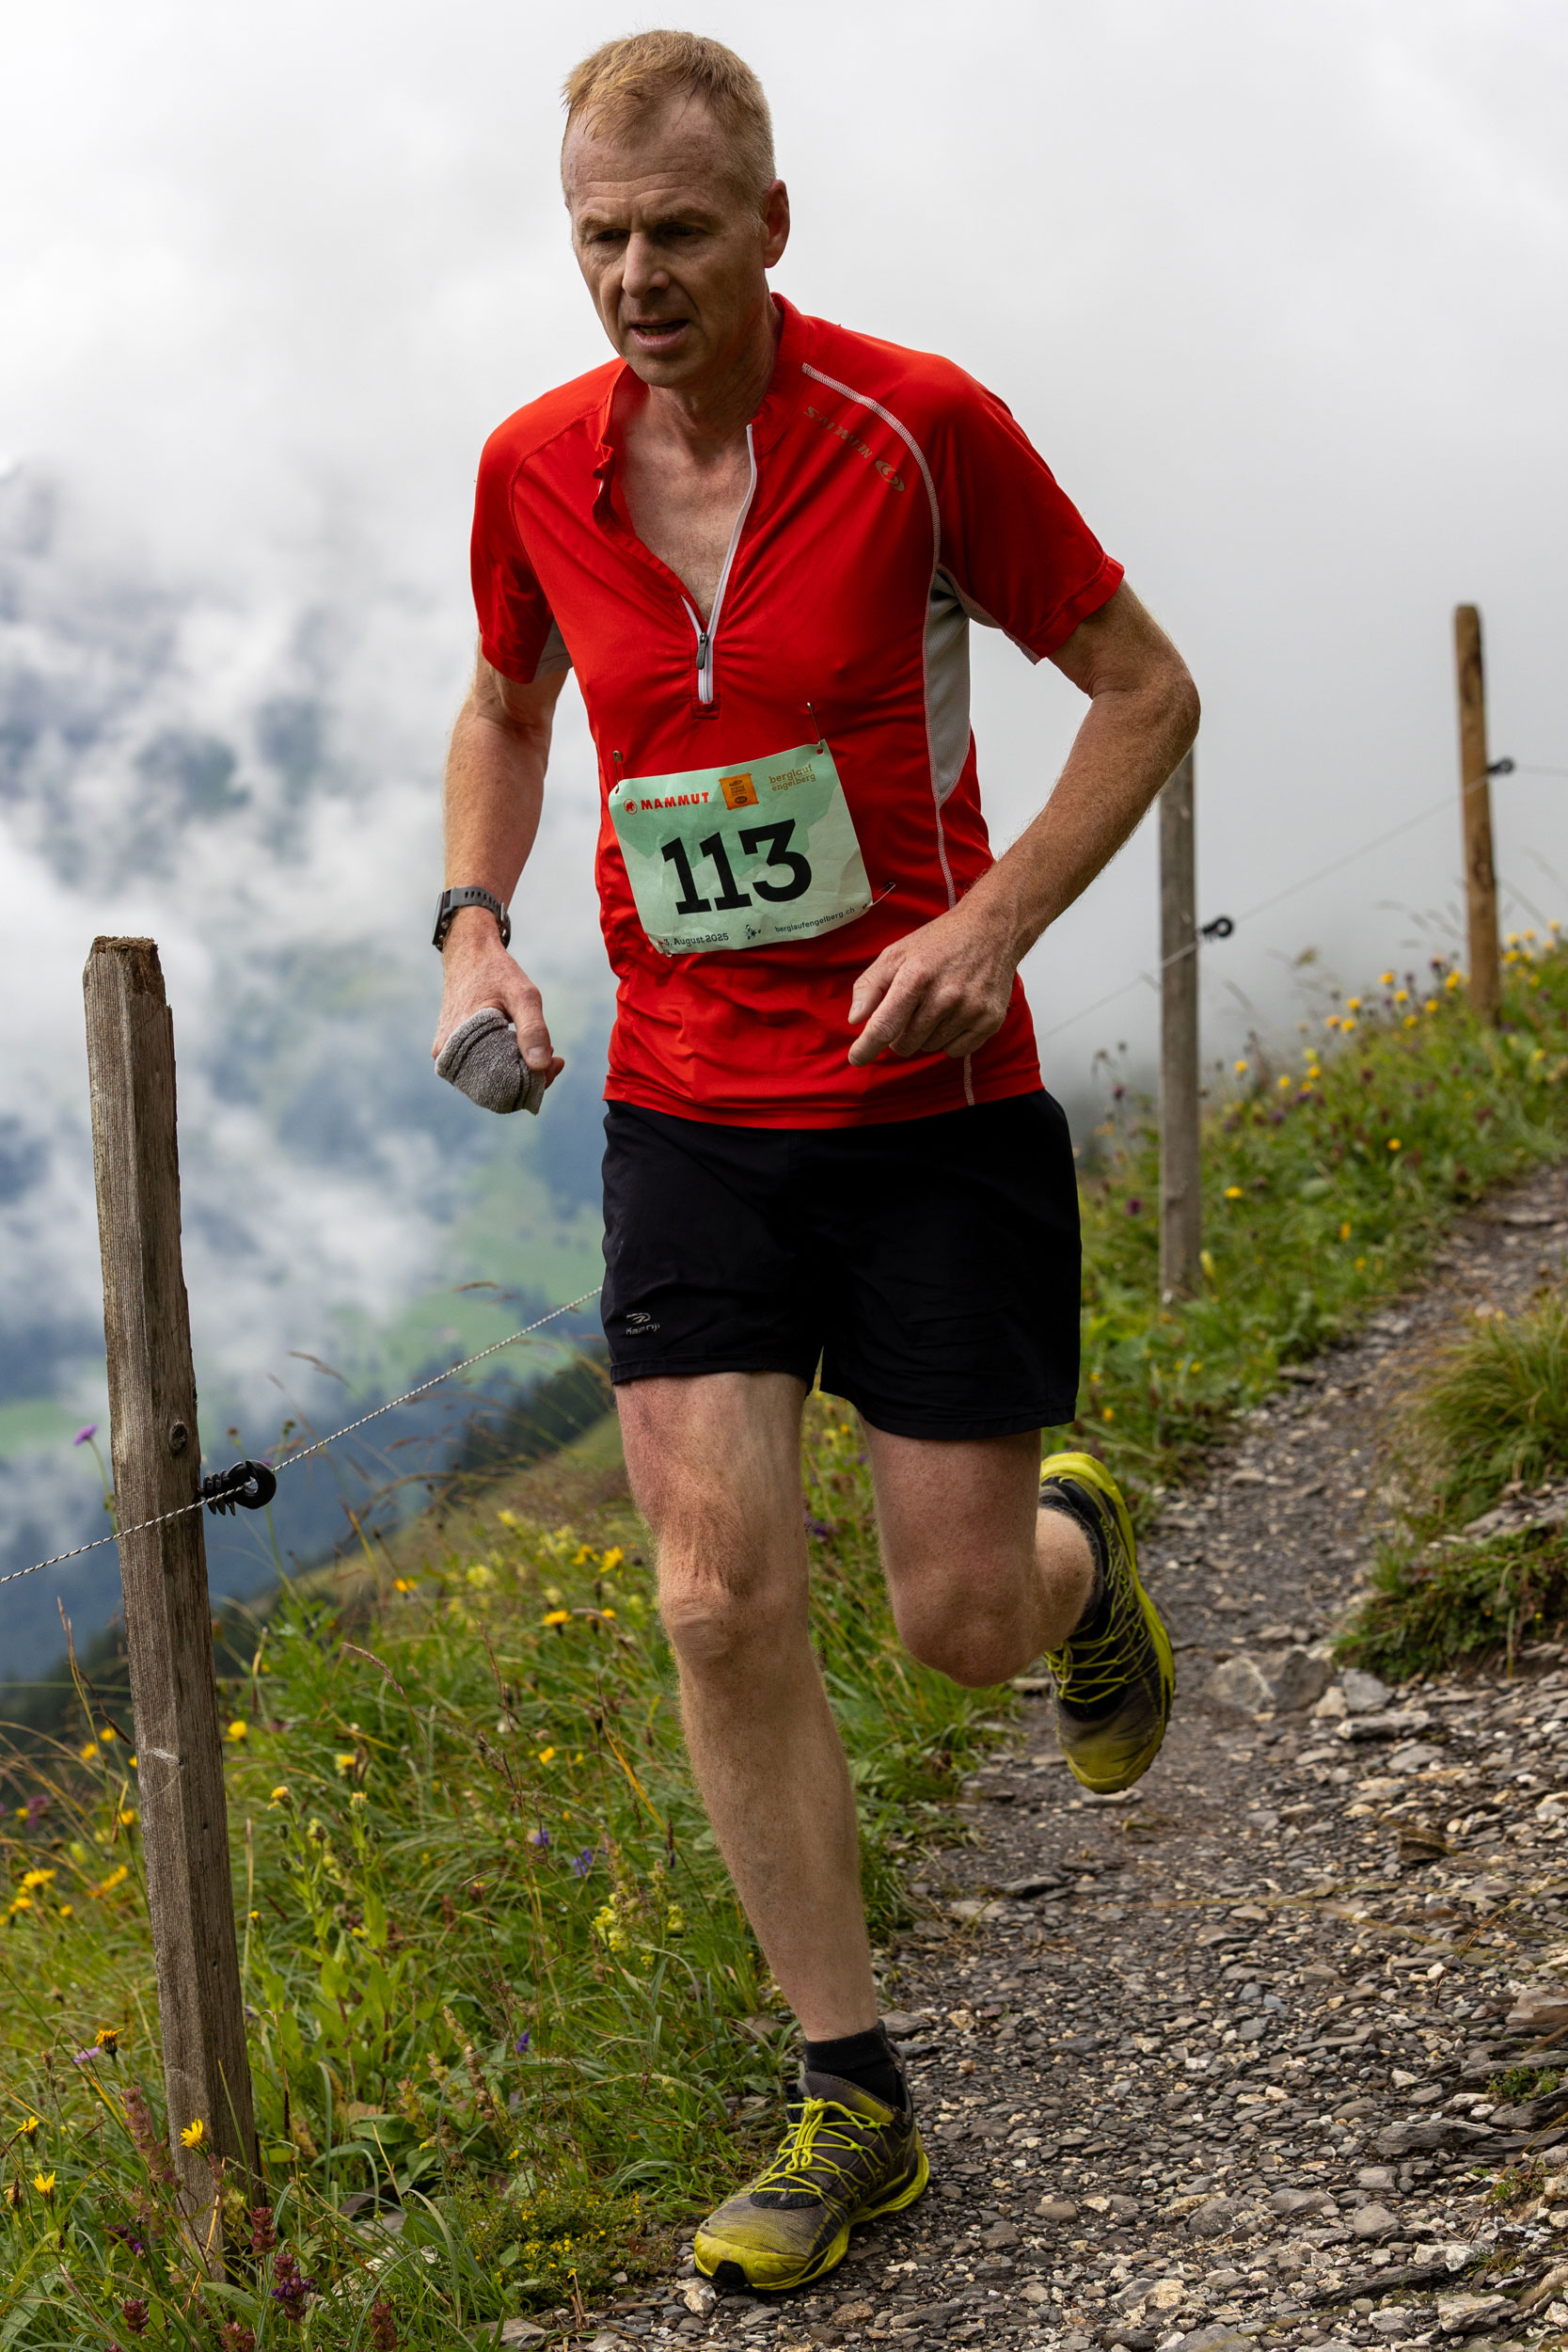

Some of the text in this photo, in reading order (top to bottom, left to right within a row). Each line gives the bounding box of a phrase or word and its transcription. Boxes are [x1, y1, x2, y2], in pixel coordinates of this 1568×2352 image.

[768, 763, 814, 784] berglauf
[771, 773, 816, 791] engelberg
[641, 791, 709, 811] MAMMUT
[660, 818, 812, 915] 113
[774, 907, 855, 933] berglaufengelberg.ch
[673, 935, 705, 947] August
[705, 932, 729, 943] 2025
